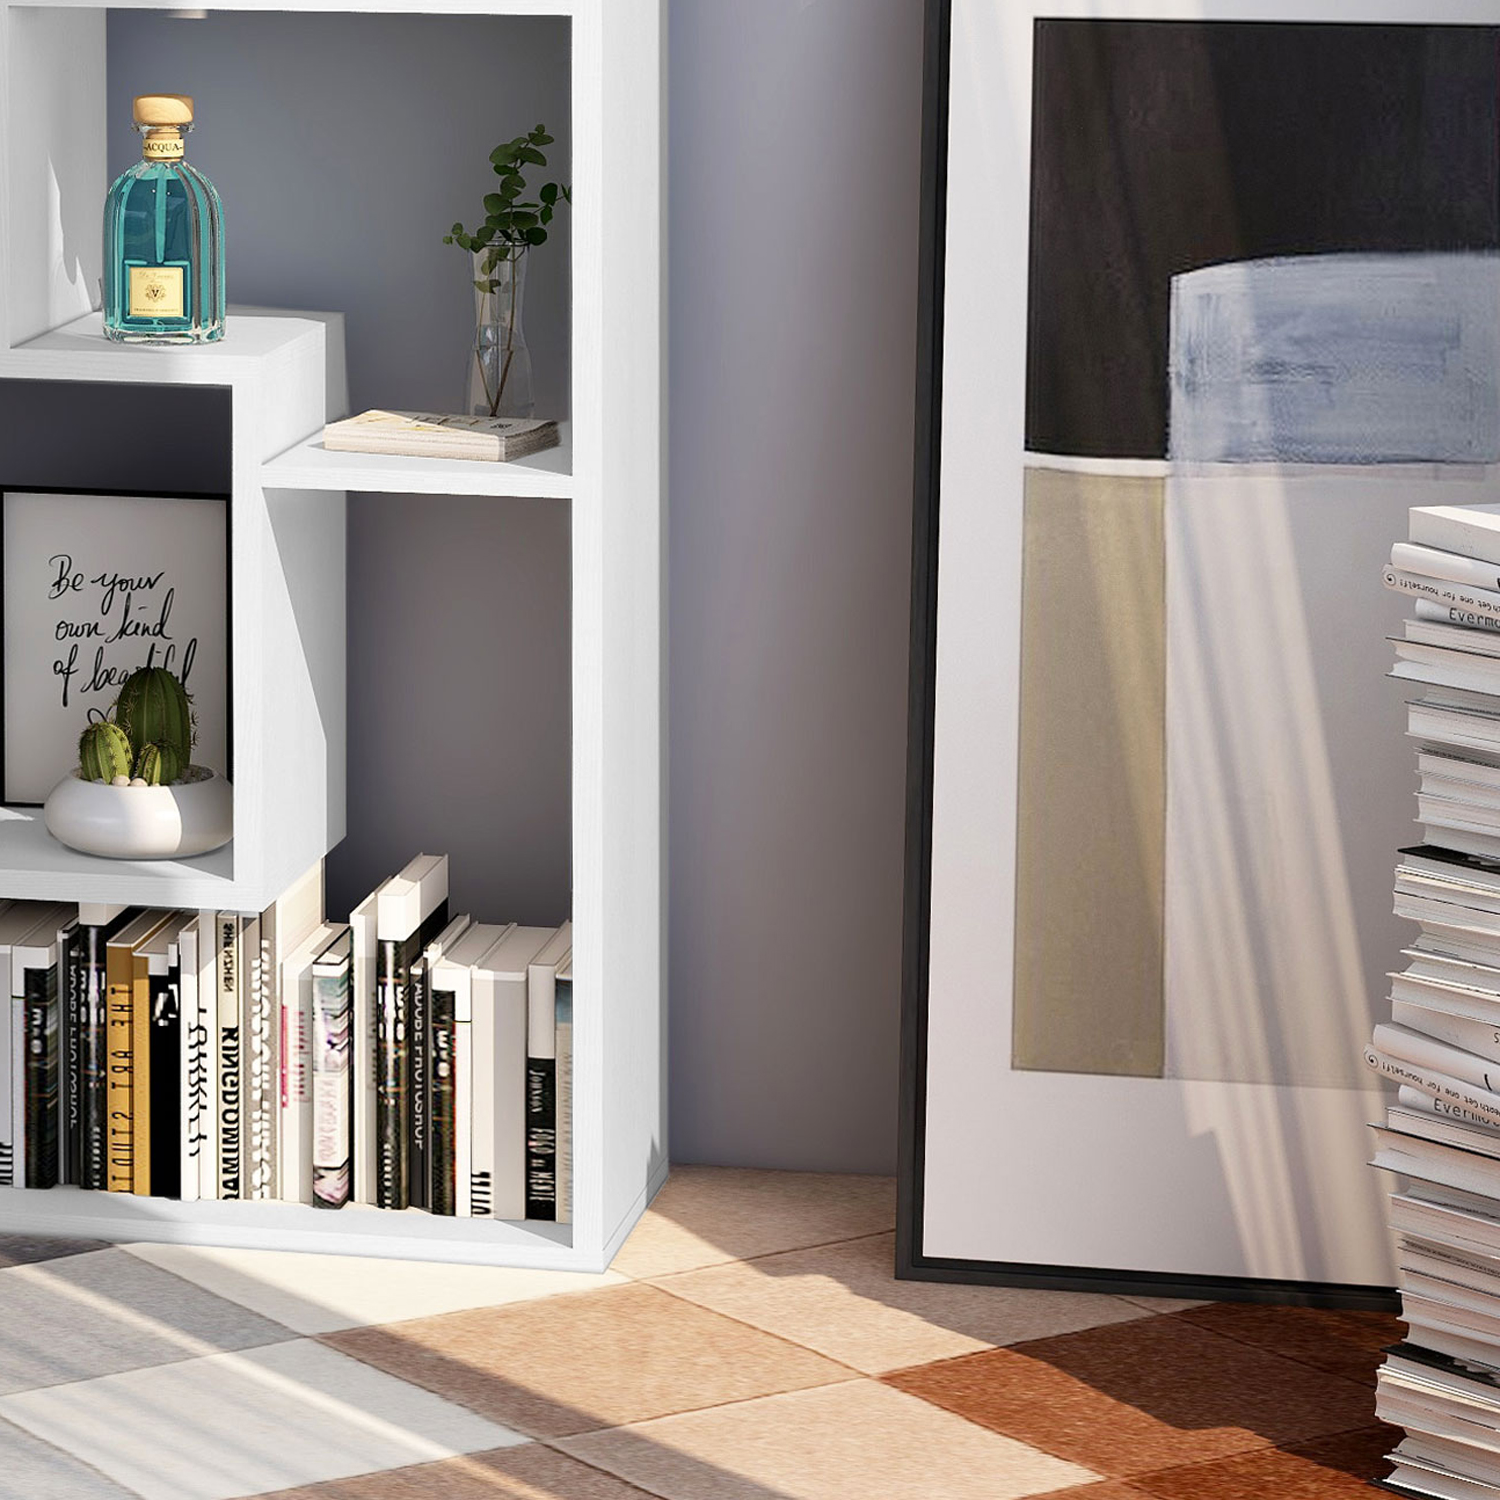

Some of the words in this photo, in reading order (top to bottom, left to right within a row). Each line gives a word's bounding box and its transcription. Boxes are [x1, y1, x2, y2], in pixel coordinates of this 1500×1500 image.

[49, 554, 84, 599] Be
[90, 571, 165, 615] your
[55, 619, 105, 640] own
[104, 588, 174, 643] kind
[53, 644, 78, 707] of
